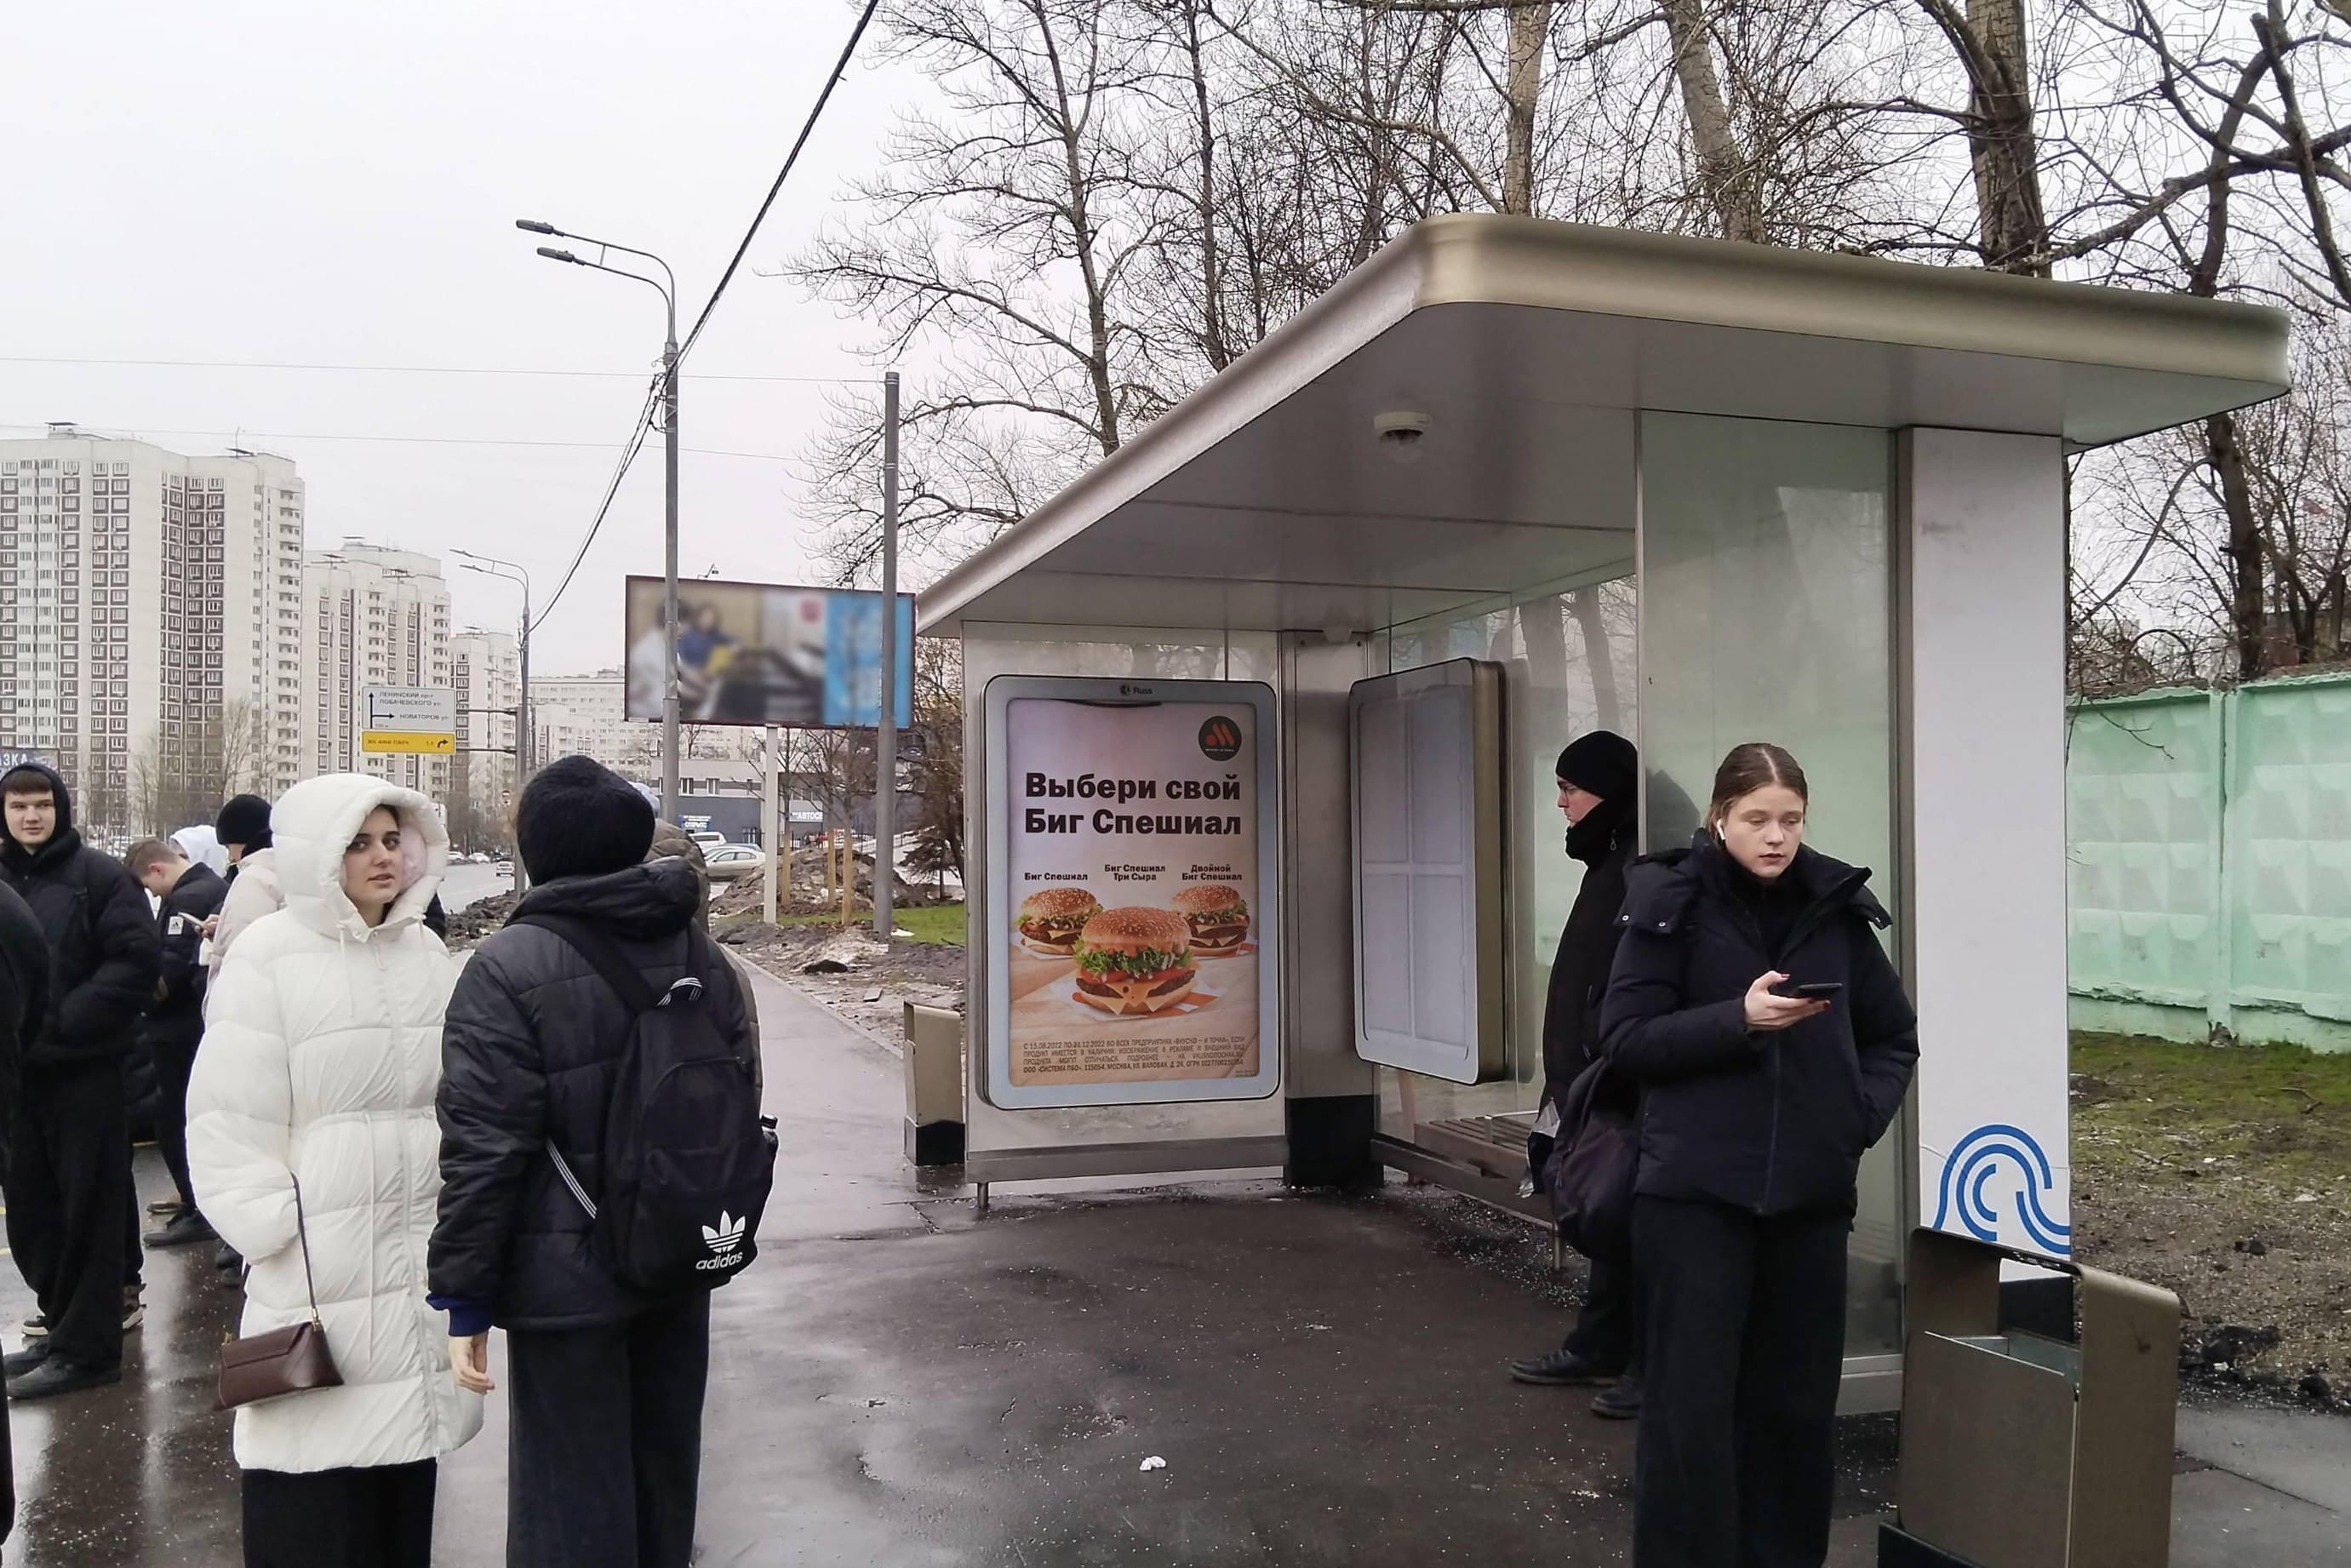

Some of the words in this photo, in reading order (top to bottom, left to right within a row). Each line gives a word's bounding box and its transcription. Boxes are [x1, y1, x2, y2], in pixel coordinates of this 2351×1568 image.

[1133, 686, 1153, 695] Russ
[0, 753, 27, 766] ЗКА
[1026, 772, 1156, 804] Выбери
[1165, 774, 1240, 800] свой
[1025, 808, 1084, 833] Биг
[1092, 809, 1241, 835] Спешиал
[1191, 863, 1231, 873] Двойной
[1113, 873, 1130, 882] Три
[1131, 873, 1157, 882] Сыра
[695, 1251, 743, 1270] adidas
